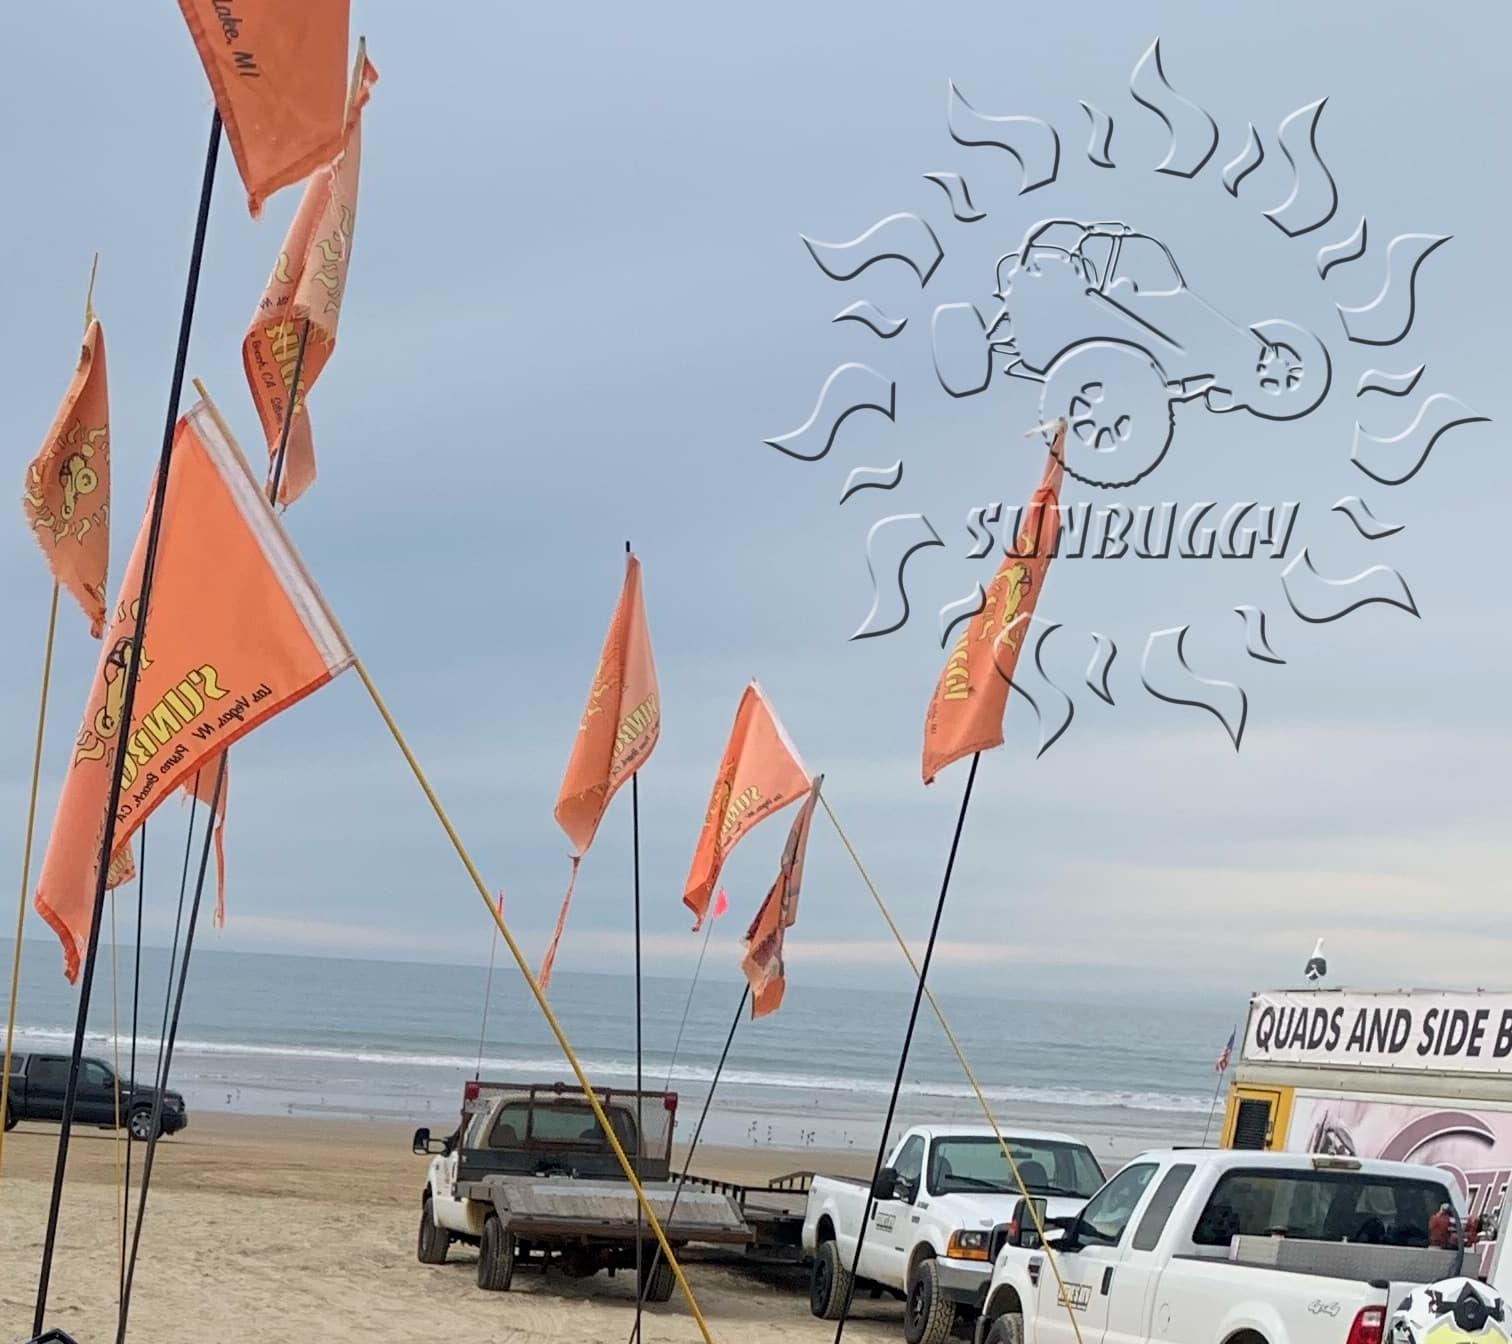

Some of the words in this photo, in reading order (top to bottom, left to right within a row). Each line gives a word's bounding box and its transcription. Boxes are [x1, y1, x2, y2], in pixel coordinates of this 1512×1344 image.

[231, 50, 261, 78] MI
[1255, 1006, 1345, 1053] QUADS
[1345, 1008, 1413, 1054] AND
[1416, 1008, 1491, 1057] SIDE
